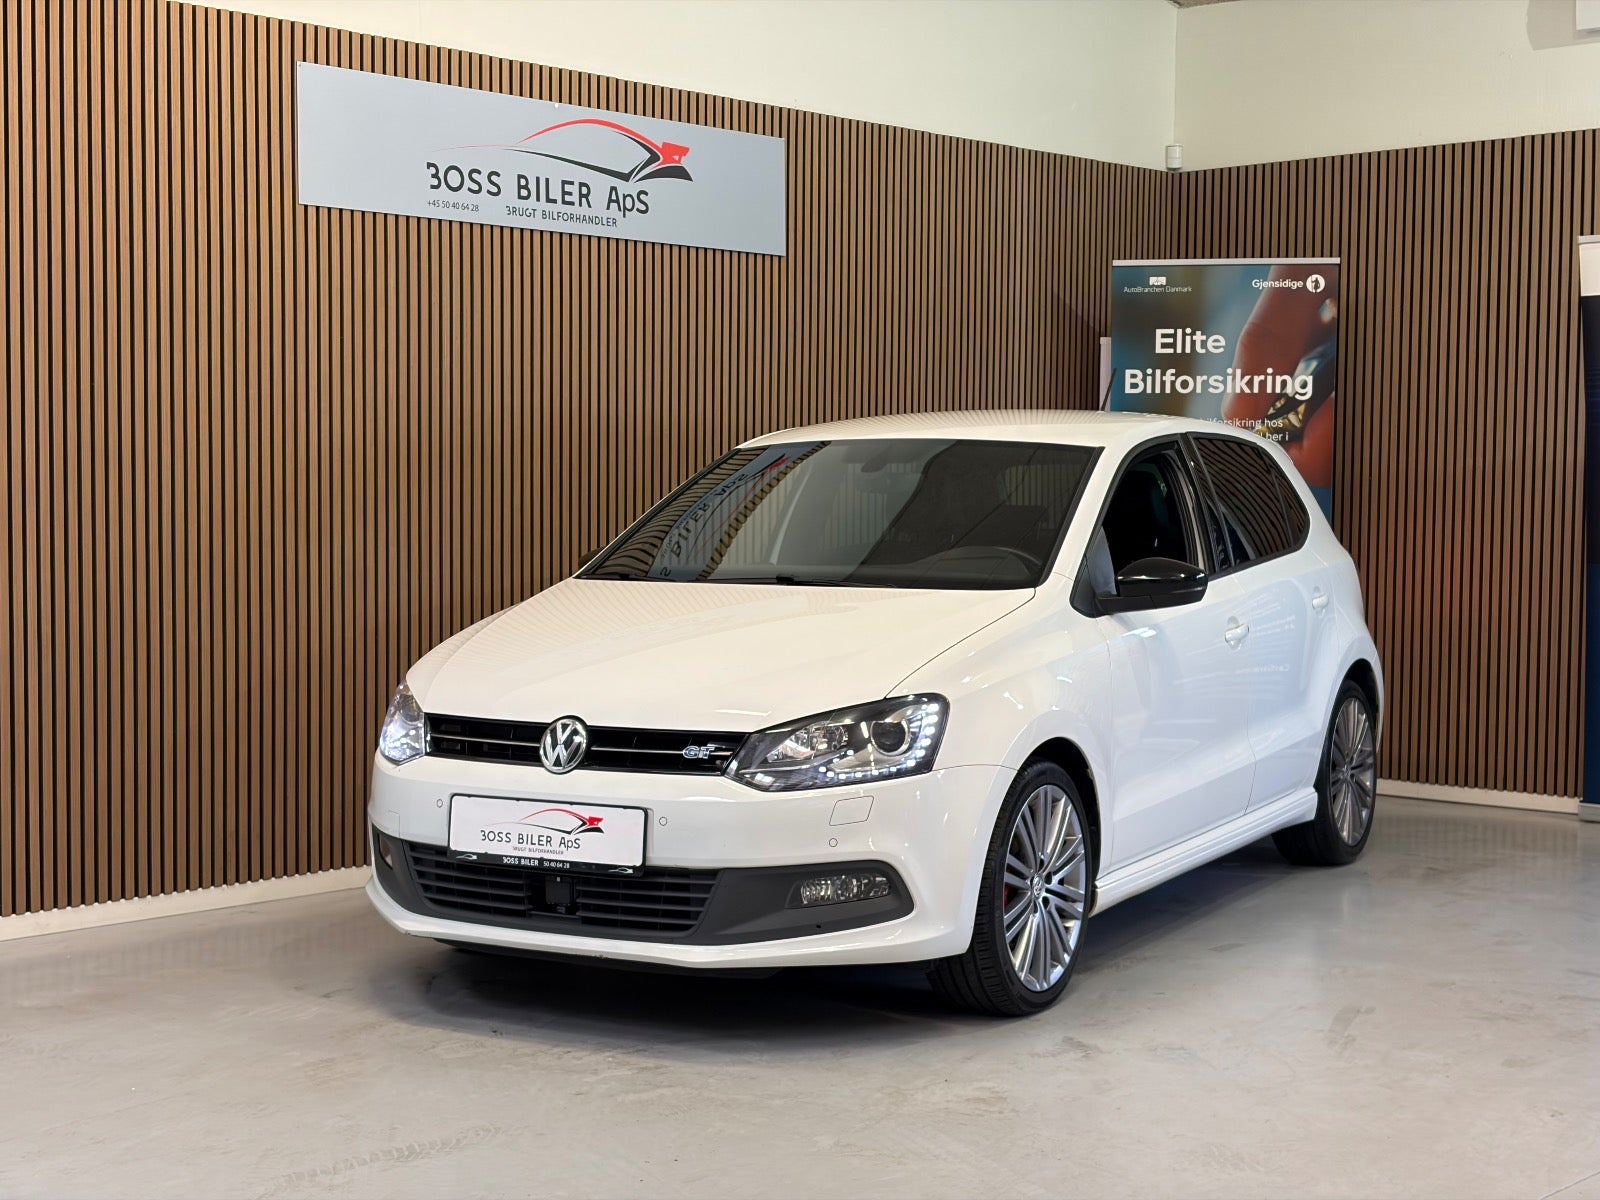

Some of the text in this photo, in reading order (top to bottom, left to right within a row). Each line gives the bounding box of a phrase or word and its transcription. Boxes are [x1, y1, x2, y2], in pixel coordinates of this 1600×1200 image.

[517, 174, 592, 208] BILER
[606, 186, 650, 218] ApS
[427, 200, 480, 213] +45 50 40 64 28
[541, 210, 618, 228] BILFORHANDLER
[1165, 285, 1193, 293] Danmark
[1251, 279, 1304, 290] Gjensidige
[1155, 327, 1226, 354] Elite
[1124, 367, 1314, 401] Bilforsikring
[1206, 417, 1284, 430] orsikring hos
[682, 745, 715, 759] GT
[517, 833, 553, 847] BILER
[558, 836, 581, 851] ApS
[520, 858, 539, 867] BILER
